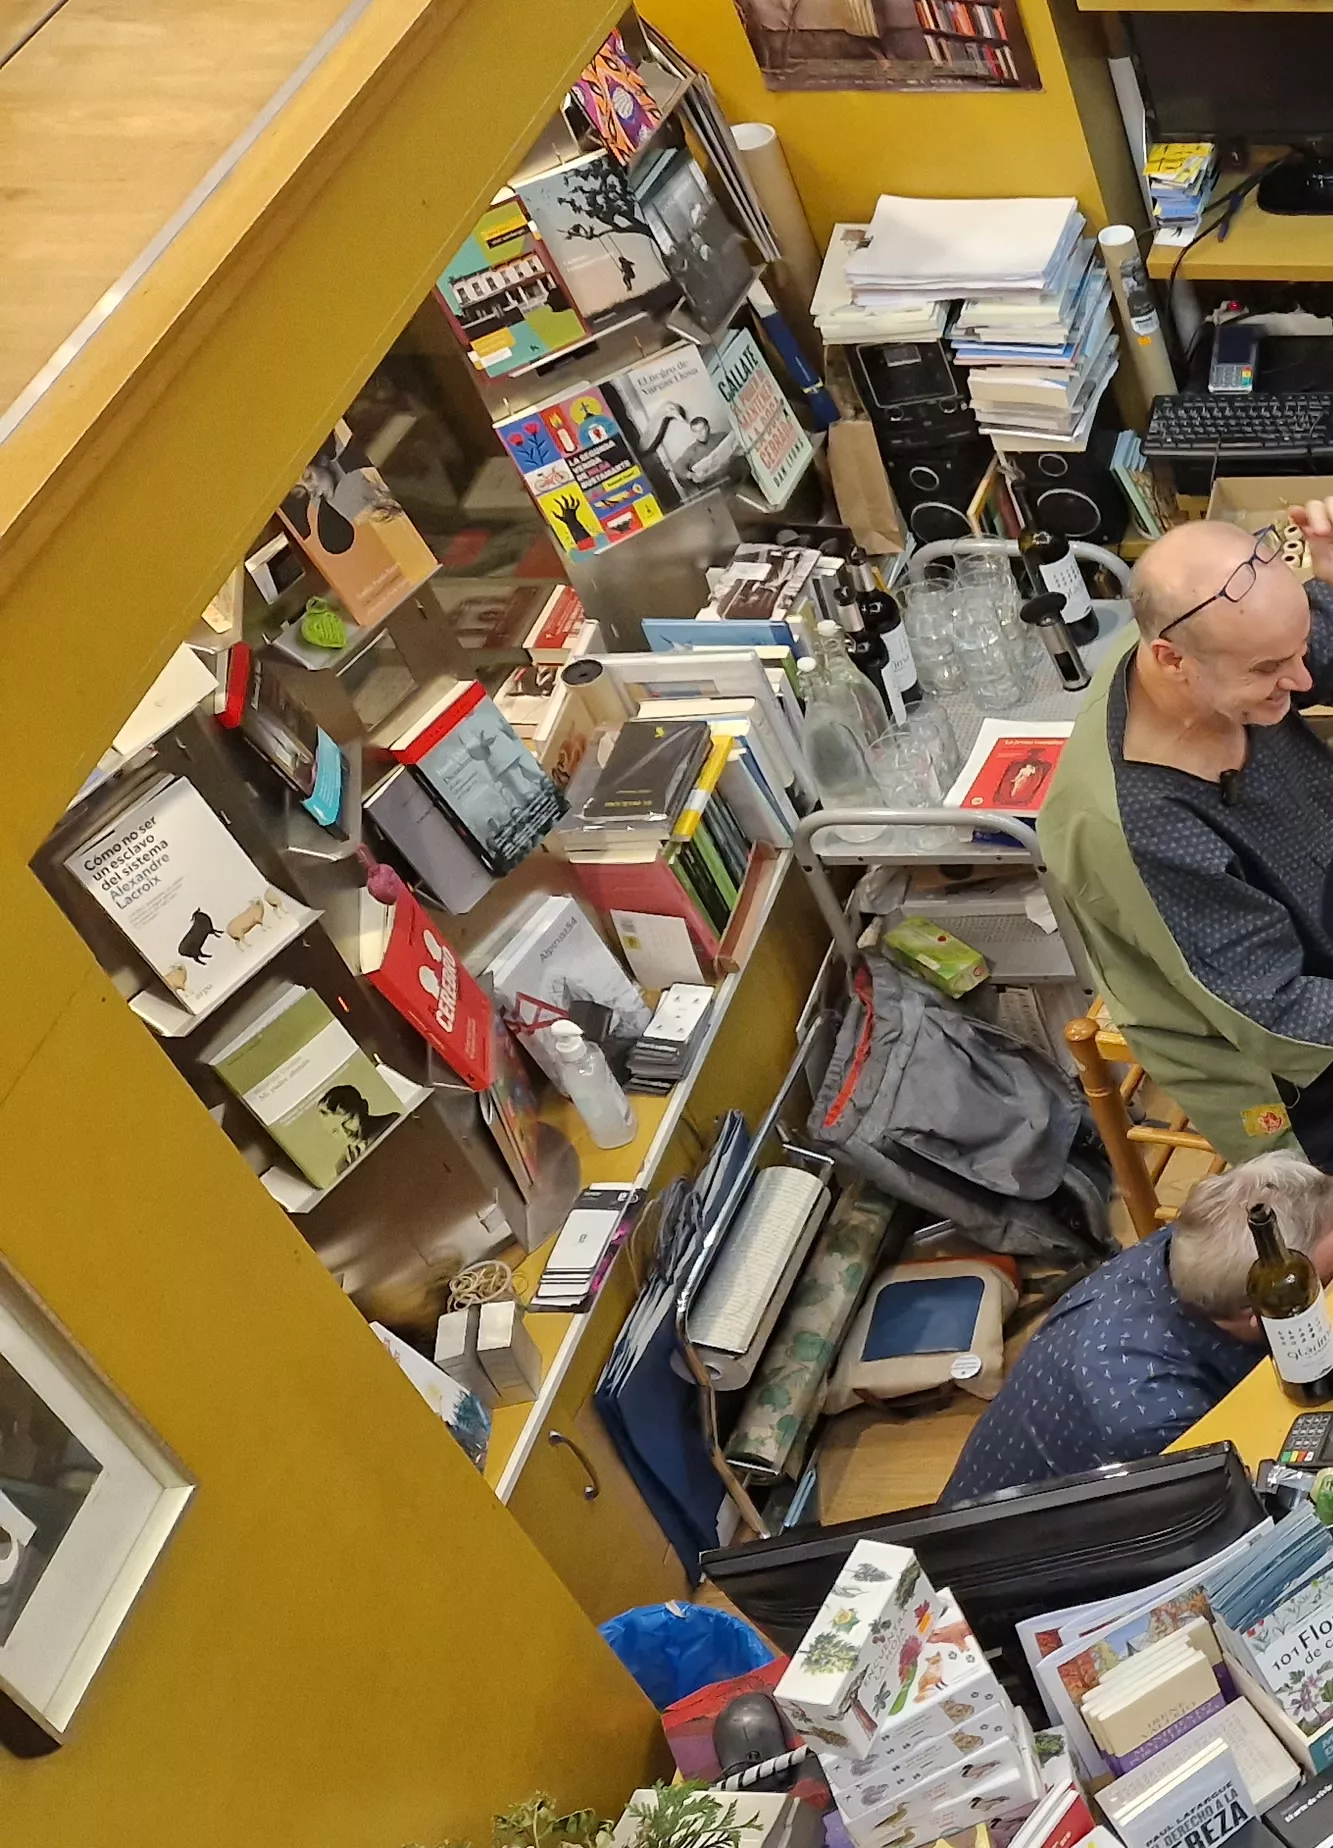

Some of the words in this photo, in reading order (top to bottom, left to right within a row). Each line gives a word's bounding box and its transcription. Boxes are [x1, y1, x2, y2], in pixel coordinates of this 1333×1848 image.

[641, 376, 673, 396] Vargas
[674, 366, 700, 386] Llosa
[649, 364, 676, 387] negro
[677, 359, 689, 370] de
[773, 468, 788, 488] DAN
[84, 841, 122, 872] Cómo
[121, 830, 139, 847] no
[138, 815, 157, 836] ser
[92, 866, 111, 882] un
[110, 834, 155, 870] esclavo
[101, 873, 121, 892] del
[122, 838, 169, 878] sistema
[110, 853, 170, 901] Alexandre
[116, 875, 162, 910] Lacroix
[435, 945, 458, 1034] CEREBRO
[1272, 1646, 1300, 1671] 101
[1305, 1647, 1322, 1665] de
[1139, 1700, 1198, 1741] VALLEJO
[1146, 1702, 1188, 1729] IRENE
[1146, 1822, 1174, 1847] PAUL
[1175, 1780, 1235, 1824] LAFARGUE
[1162, 1804, 1215, 1848] DERECHO
[1215, 1799, 1226, 1812] A
[1224, 1787, 1240, 1804] LA
